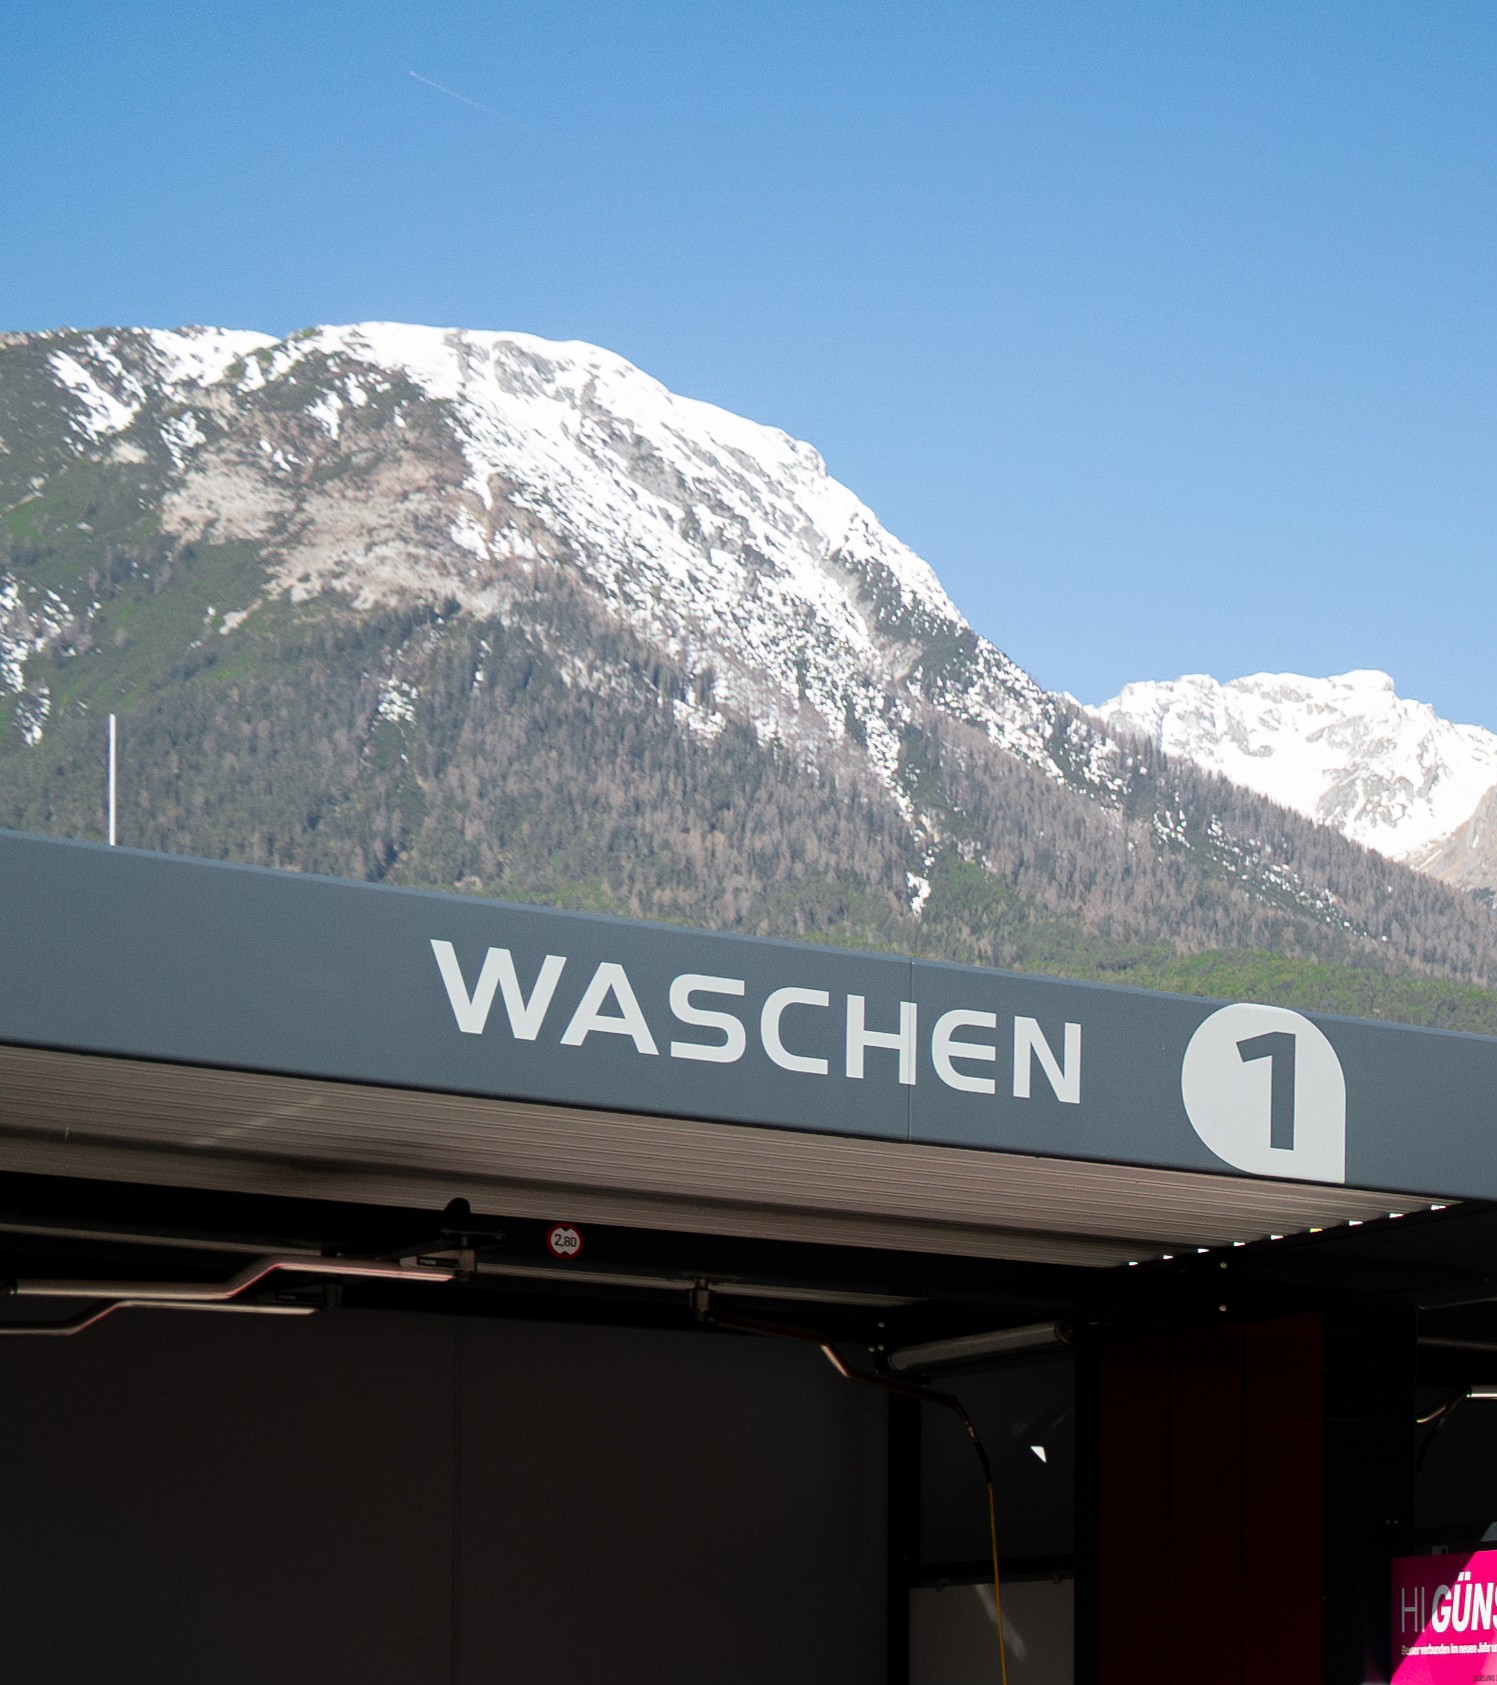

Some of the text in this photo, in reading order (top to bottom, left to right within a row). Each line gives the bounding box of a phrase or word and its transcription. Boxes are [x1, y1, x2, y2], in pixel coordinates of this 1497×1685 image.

[430, 938, 1297, 1150] WASCHEN 1
[1401, 1587, 1425, 1633] HI
[1420, 1642, 1450, 1655] verbunden
[1450, 1643, 1458, 1654] im
[1459, 1644, 1477, 1654] neuen
[1477, 1642, 1491, 1654] Jahr
